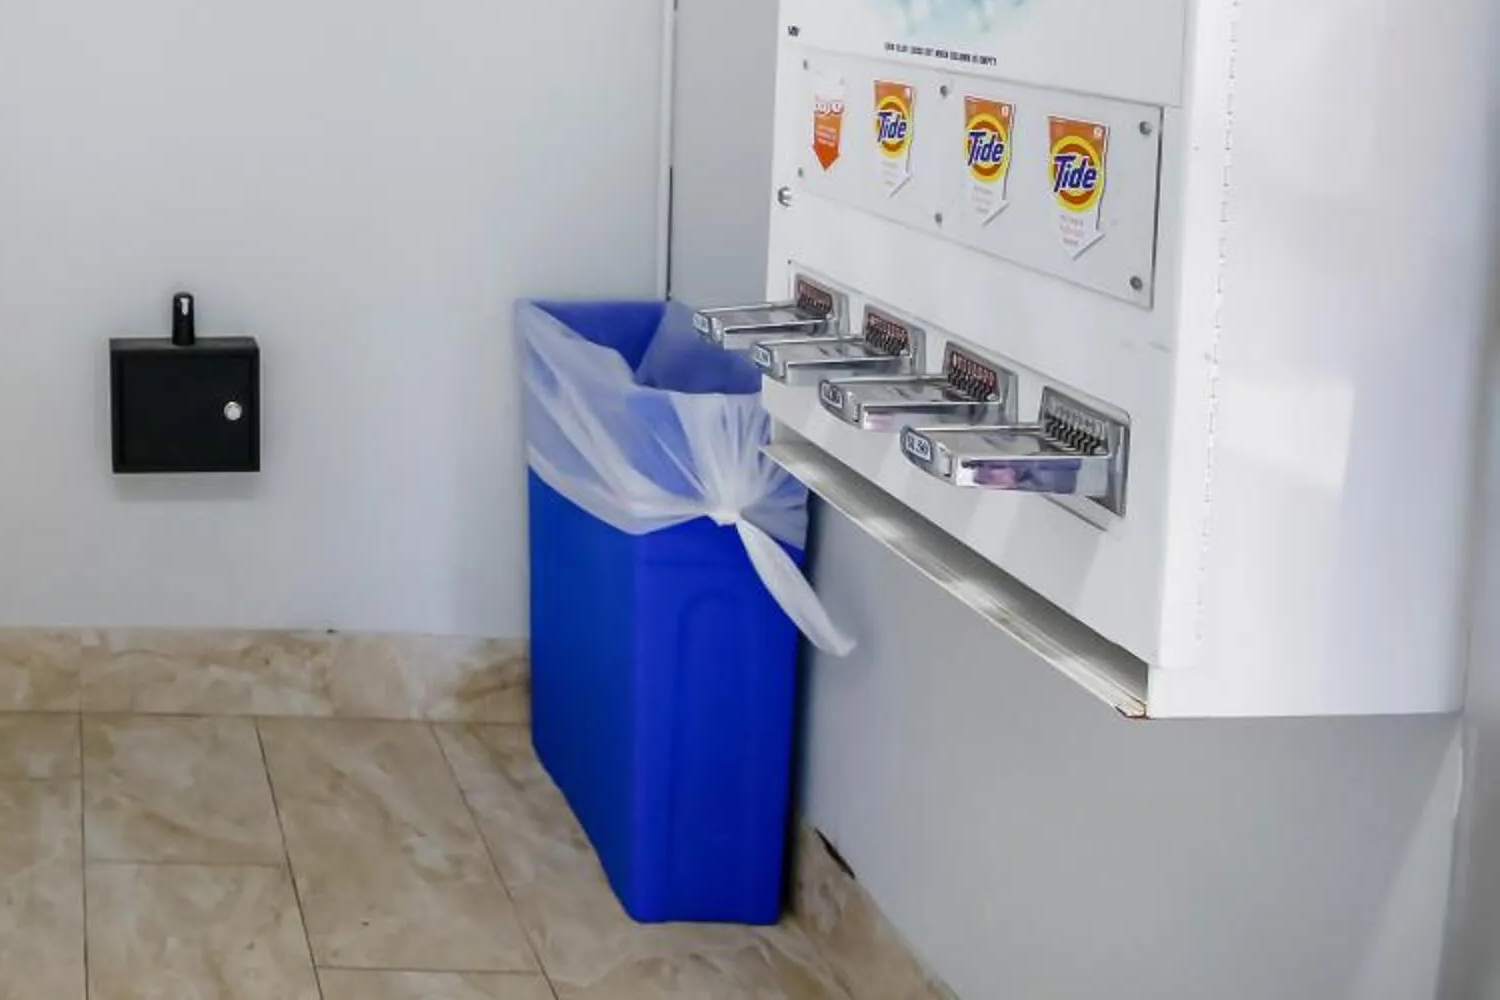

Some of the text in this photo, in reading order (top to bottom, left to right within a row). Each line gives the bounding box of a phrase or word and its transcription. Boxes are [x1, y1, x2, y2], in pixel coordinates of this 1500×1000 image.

[877, 111, 907, 143] Tide
[967, 130, 1005, 168] Tide
[1053, 154, 1098, 193] Tide
